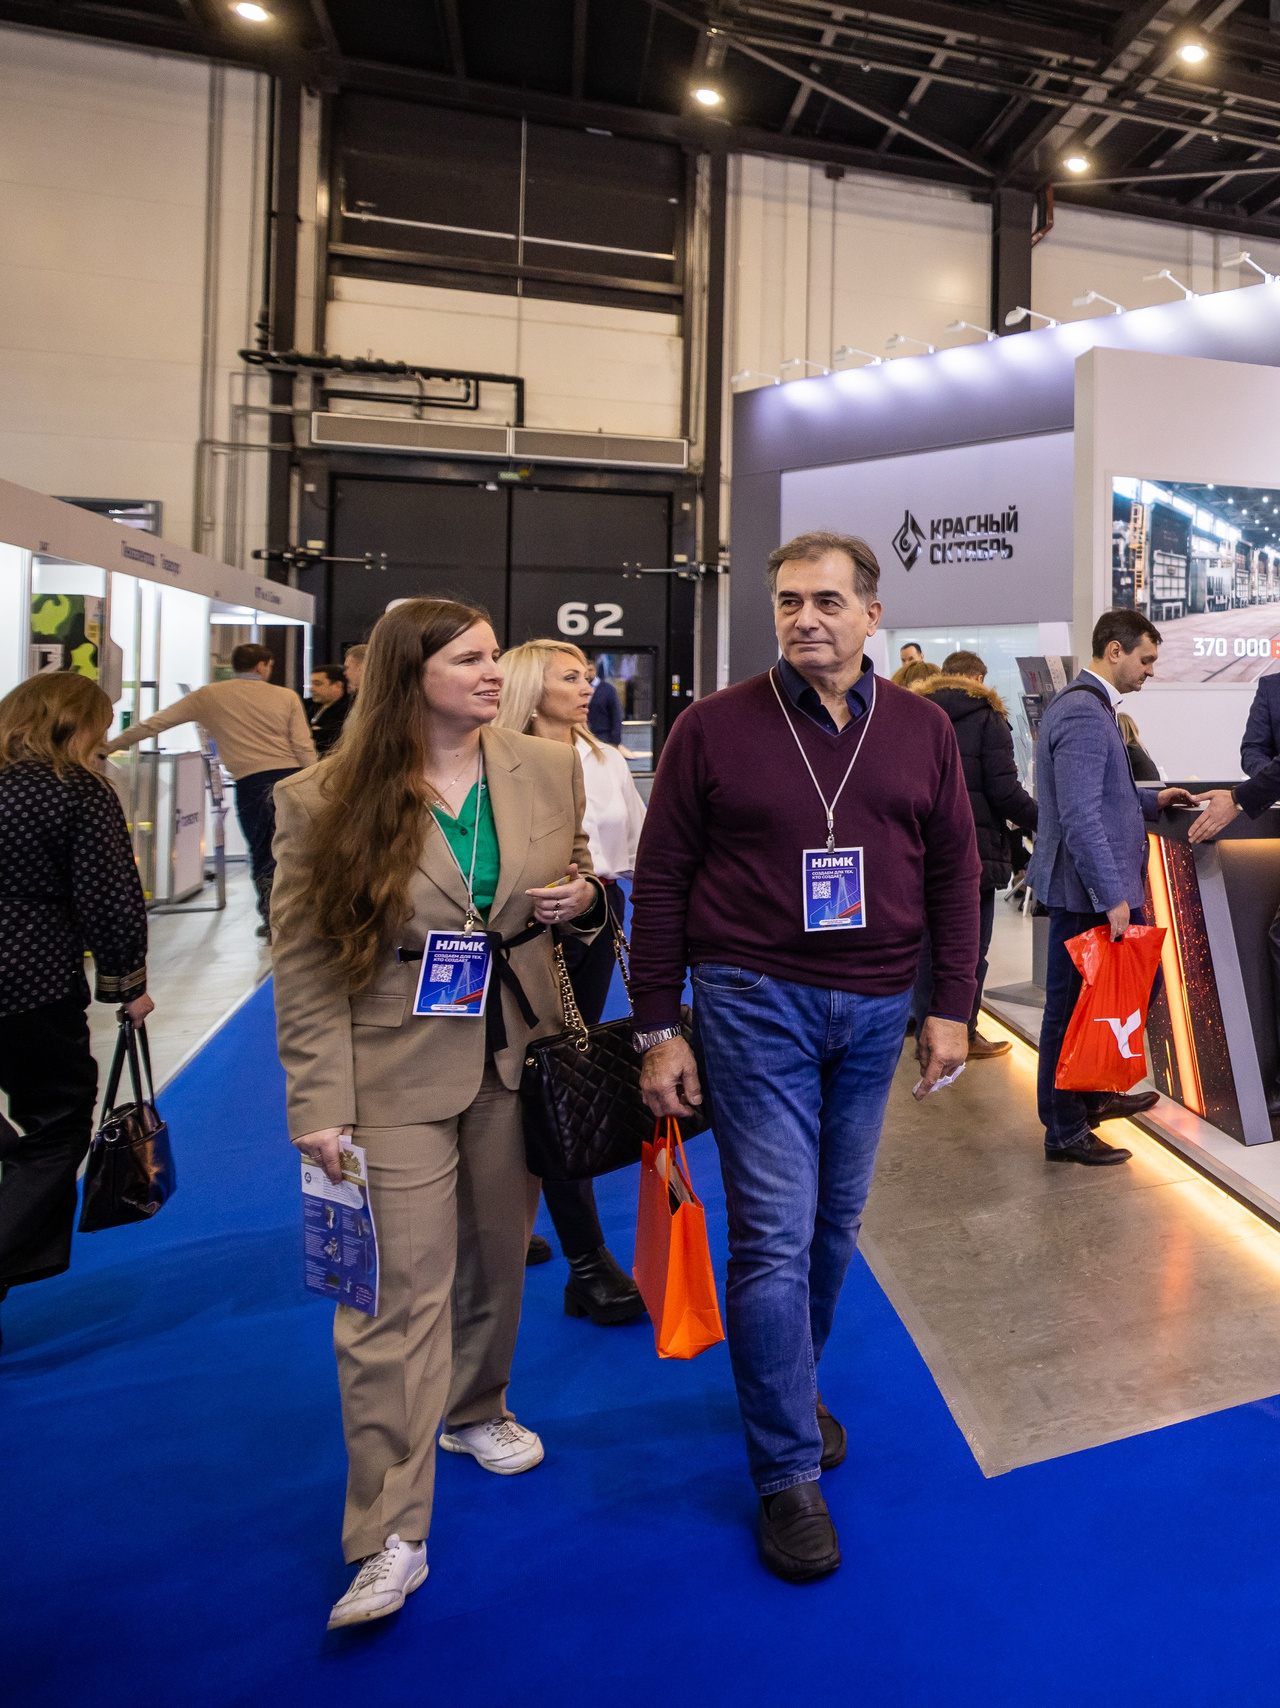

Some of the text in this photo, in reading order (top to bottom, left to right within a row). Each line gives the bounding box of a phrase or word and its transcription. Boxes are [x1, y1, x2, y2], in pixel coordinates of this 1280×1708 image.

[930, 504, 1019, 541] КРАСНЫЙ
[929, 537, 1014, 565] ОКТЯБРЬ
[556, 601, 624, 637] 62
[1192, 637, 1271, 658] 370 000
[811, 856, 854, 868] НЛМК
[435, 940, 486, 952] НЛМК
